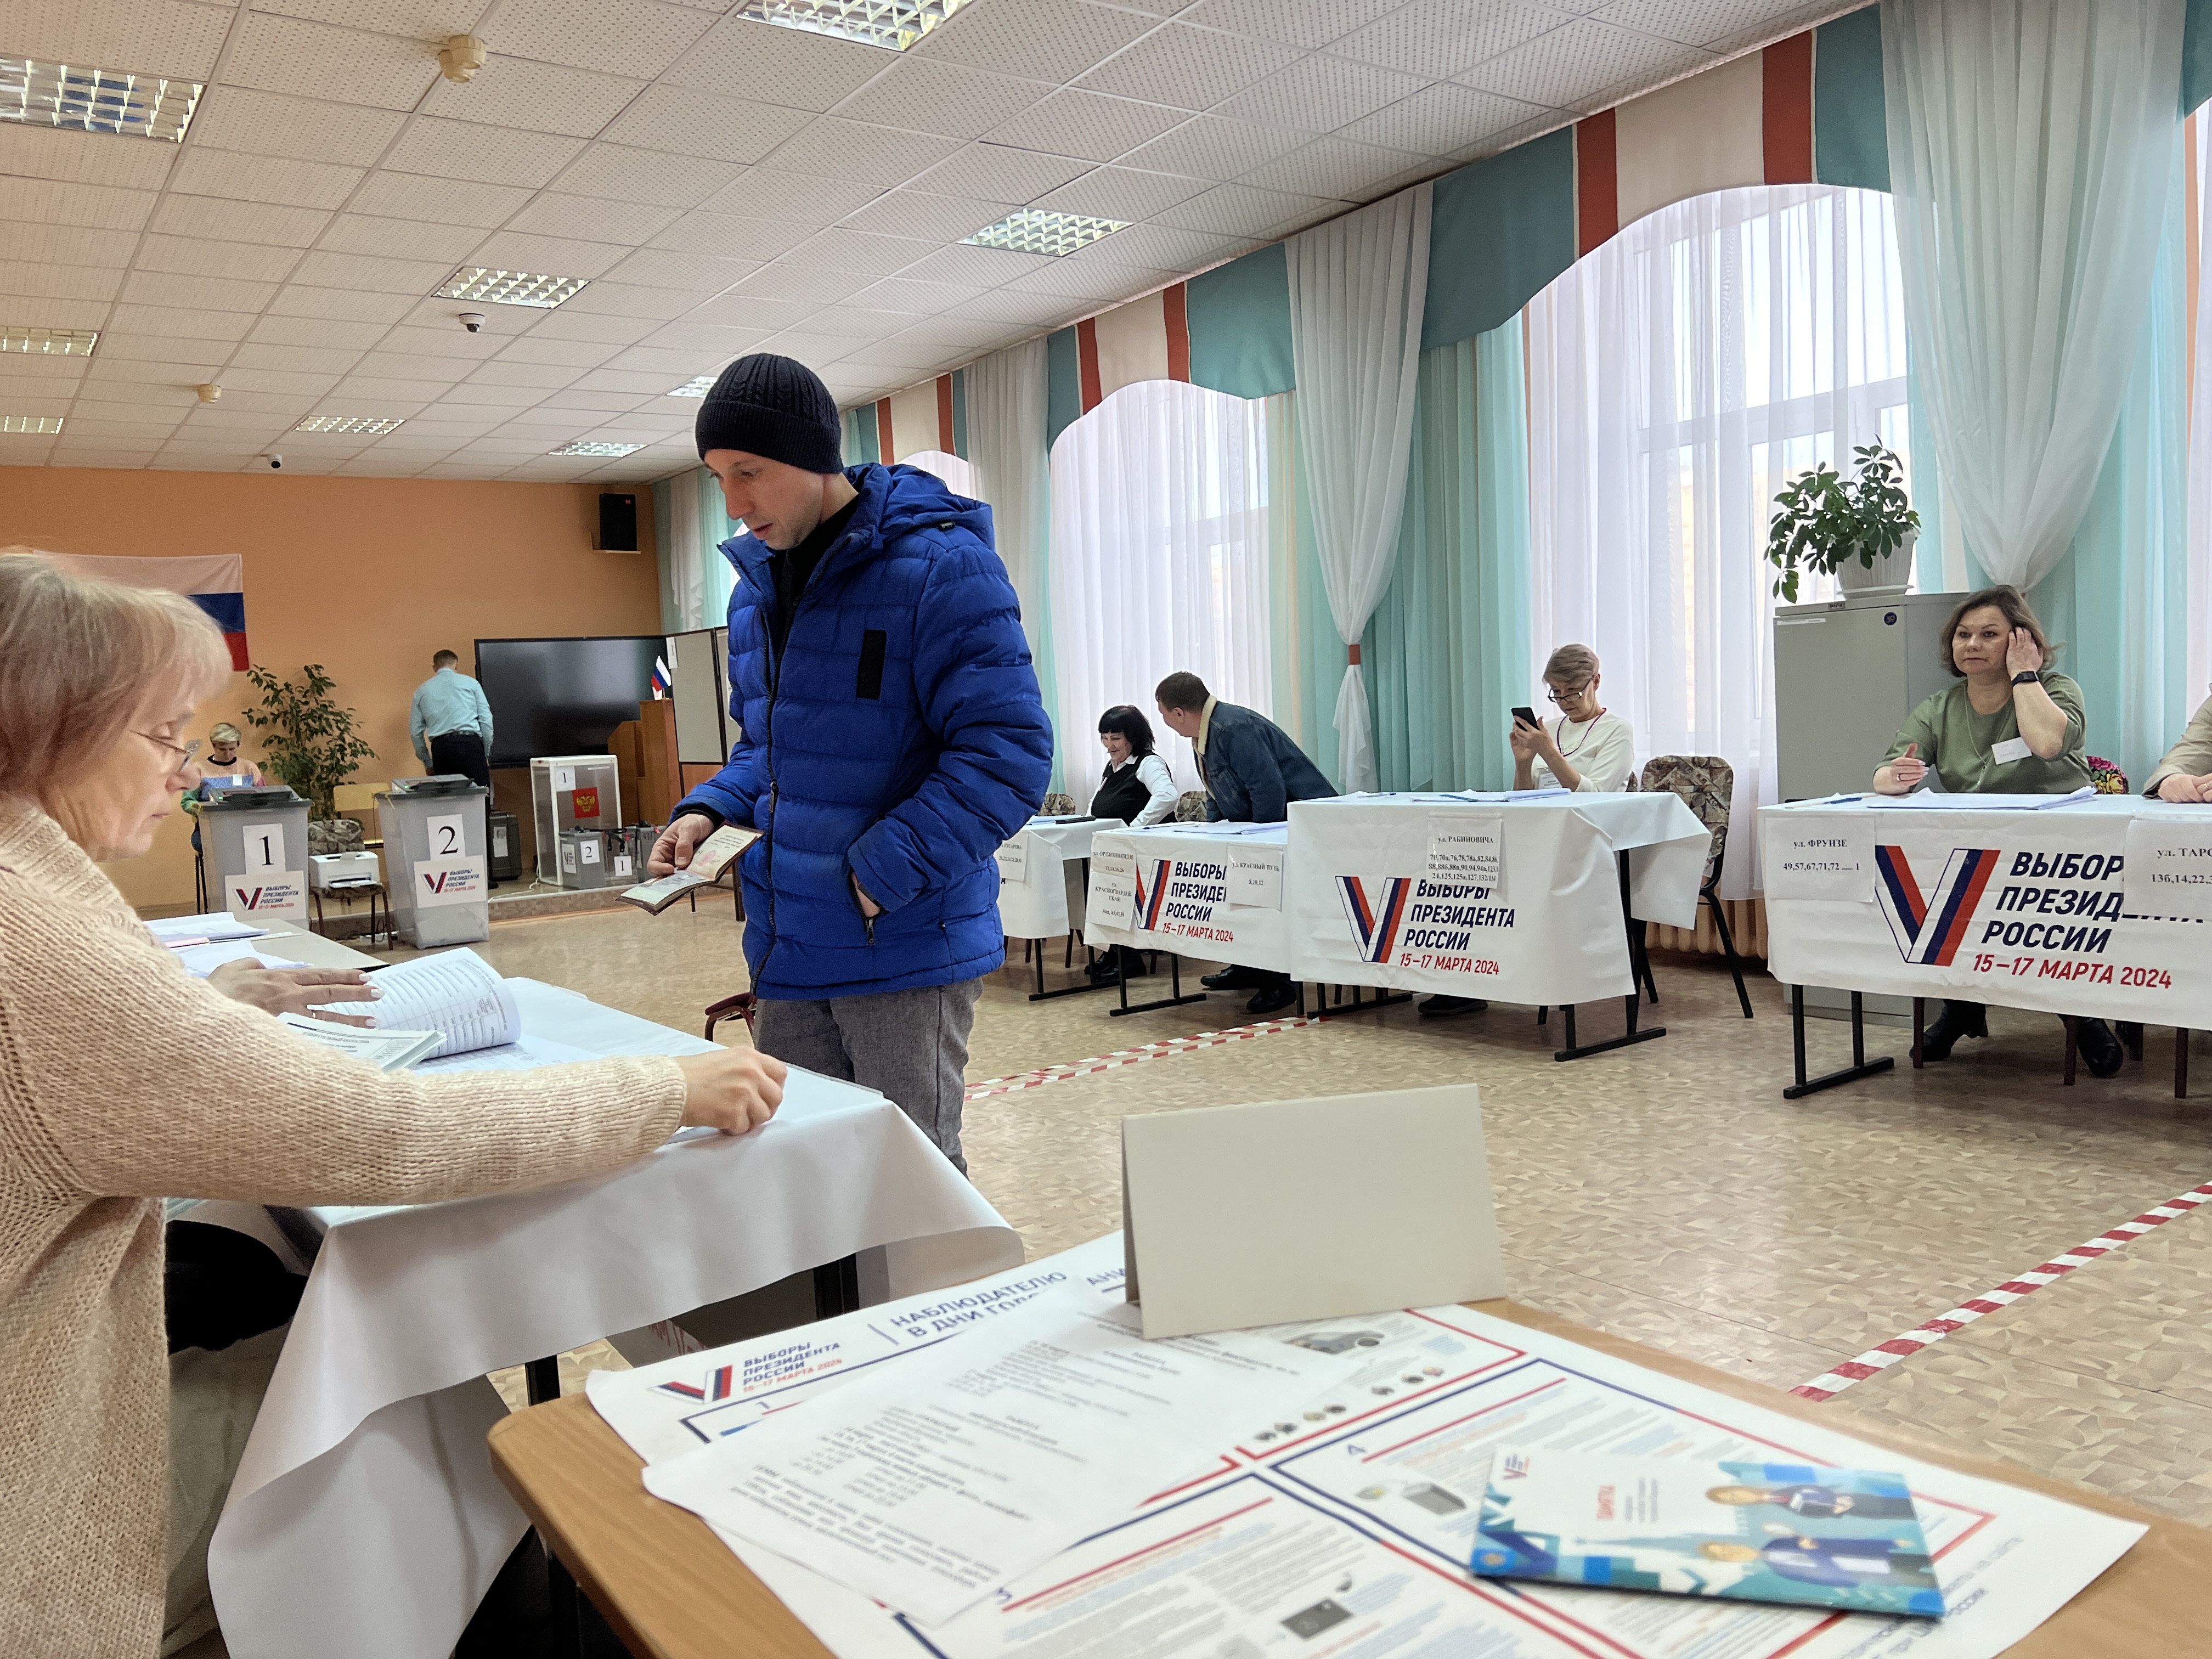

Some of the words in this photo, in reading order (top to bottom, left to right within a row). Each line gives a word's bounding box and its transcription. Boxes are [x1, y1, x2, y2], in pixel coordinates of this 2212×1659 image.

[562, 772, 567, 783] 1
[259, 835, 274, 866] 1
[438, 826, 459, 855] 2
[1793, 841, 1805, 849] ул.
[585, 846, 593, 858] 2
[2157, 850, 2175, 859] ул.
[620, 860, 625, 871] 1
[1175, 861, 1227, 881] ВЫБОРЫ
[1240, 862, 1265, 870] КРАСНЫЙ
[1783, 862, 1839, 871] 49,57,67,71,72
[1855, 862, 1859, 871] 1
[2010, 852, 2124, 881] ВЫБОР
[1171, 882, 1227, 904] ПРЕЗИДЕ
[1166, 902, 1212, 922] РОССИИ
[1410, 904, 1515, 928] ПРЕЗИДЕНТА
[1186, 926, 1213, 940] МАРТА
[1215, 929, 1233, 943] 2024
[1404, 929, 1471, 950] РОССИИ
[1981, 920, 2112, 953] РОССИИ
[1434, 956, 1472, 973] МАРТА
[1474, 960, 1499, 975] 2024
[2038, 960, 2114, 984] МАРТА
[2120, 967, 2172, 989] 2024
[890, 1272, 1067, 1327] НАБЛЮДАТЕЛЮ
[907, 1326, 927, 1338] В
[931, 1310, 984, 1332] ДНИ
[743, 1342, 841, 1376] ПРЕЗИДЕНТА
[744, 1342, 811, 1368] ВЫБОРЫ
[743, 1361, 805, 1386] РОССИИ
[776, 1367, 815, 1383] МАРТА
[817, 1358, 843, 1371] 2024
